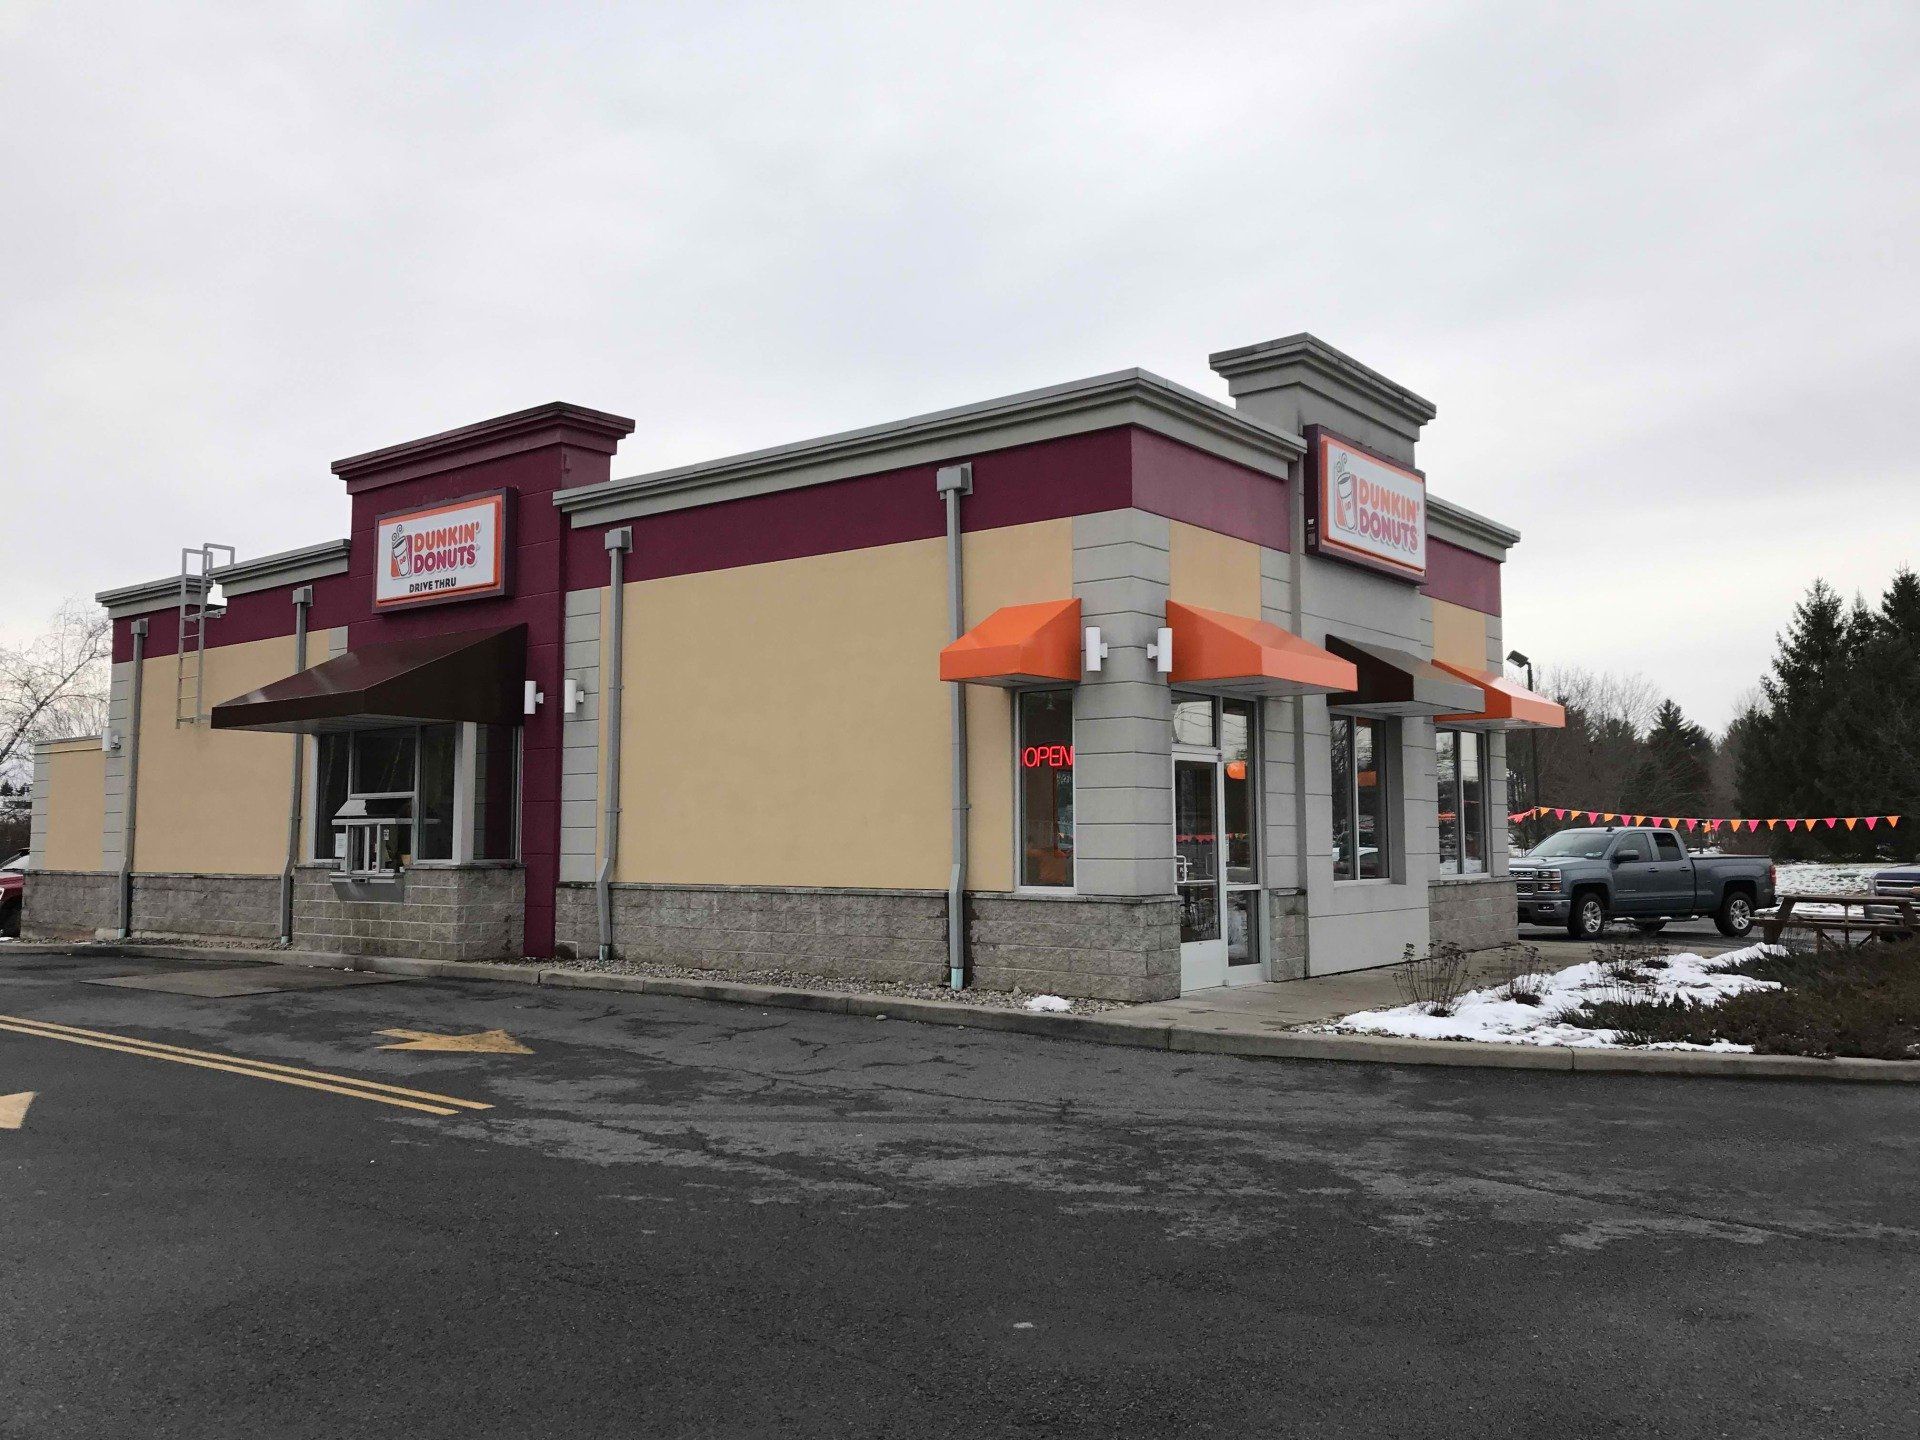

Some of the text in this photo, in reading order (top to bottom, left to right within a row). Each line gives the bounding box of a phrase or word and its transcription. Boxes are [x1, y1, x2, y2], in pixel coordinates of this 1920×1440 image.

[1358, 478, 1420, 524] DUNKIN'
[414, 521, 480, 552] DUNKIN'
[1359, 507, 1418, 551] DONUTS
[414, 544, 476, 574] DONUTS
[409, 577, 457, 593] DRIVE THRU
[1024, 745, 1074, 767] OPEN
